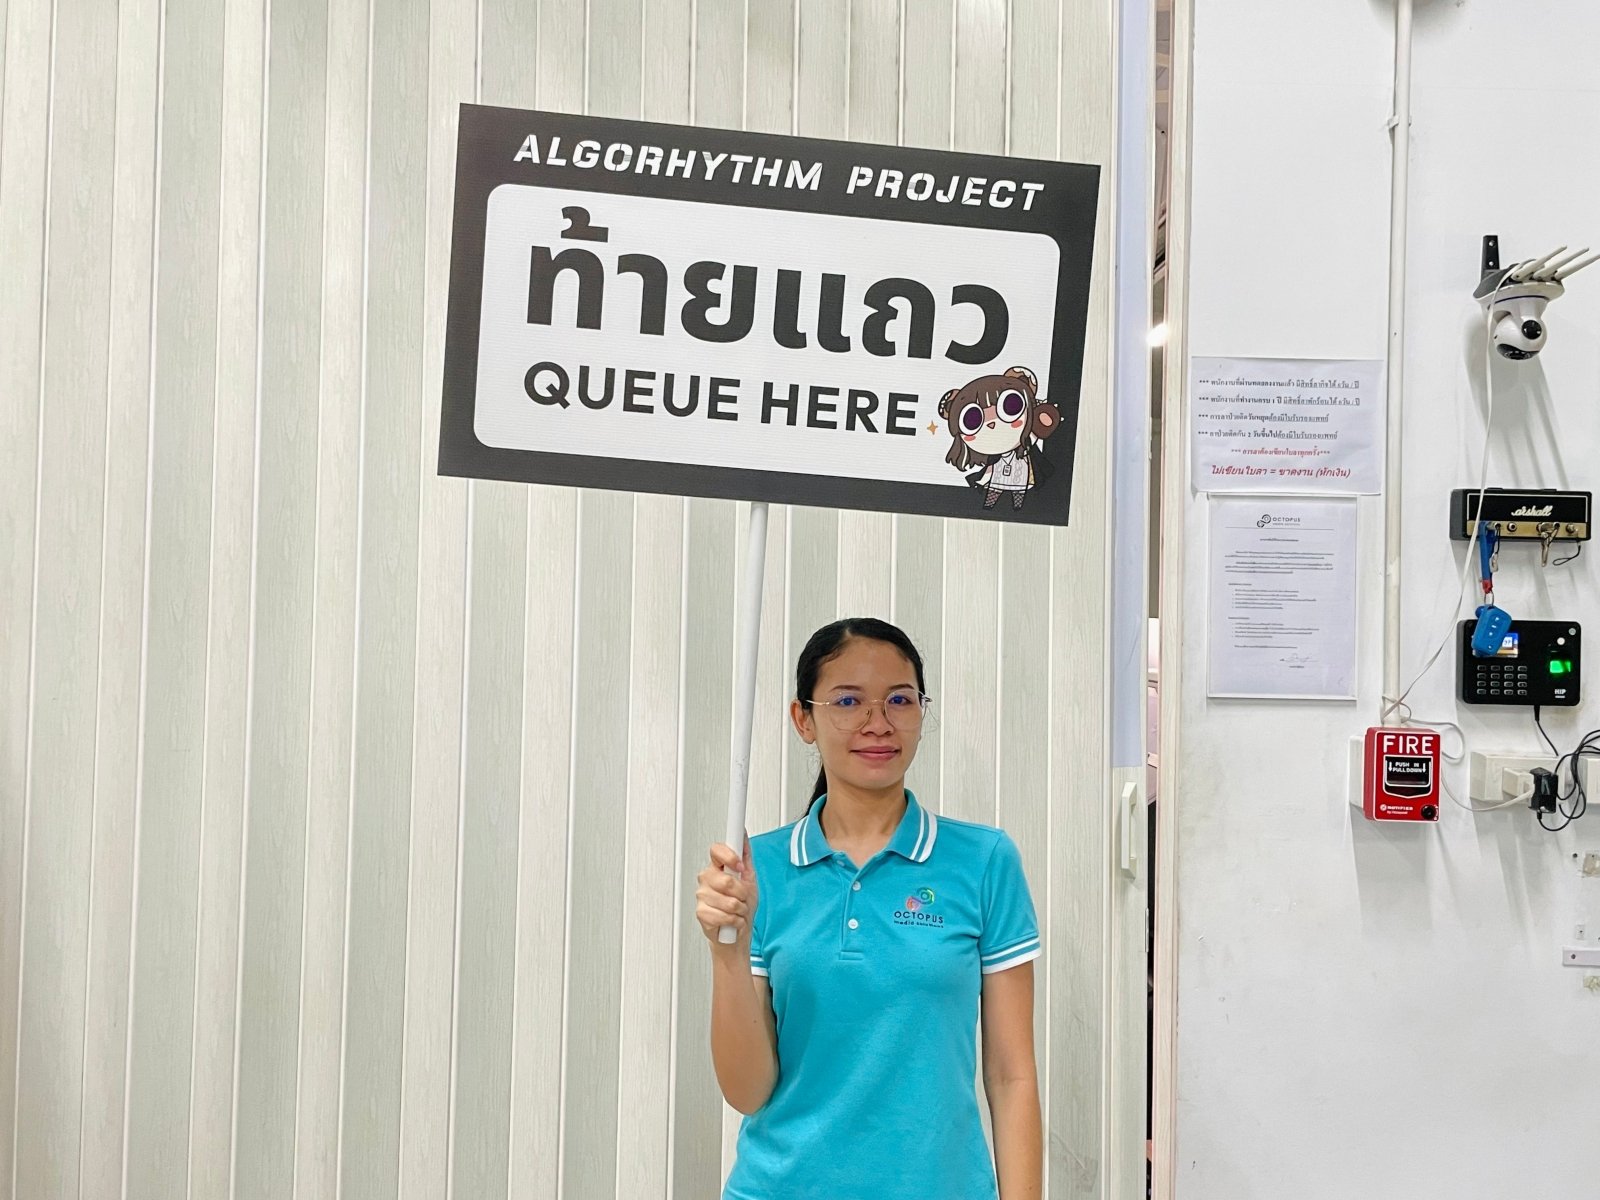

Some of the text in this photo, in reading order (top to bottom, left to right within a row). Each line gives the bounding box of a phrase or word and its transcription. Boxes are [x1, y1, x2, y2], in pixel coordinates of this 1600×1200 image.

[513, 134, 1045, 212] ALGORHYTHM PROJECT
[526, 206, 1010, 365] ท้ายแถว
[523, 361, 919, 437] QUEUE HERE
[1383, 735, 1434, 754] FIRE
[894, 911, 944, 924] OCTOPUS
